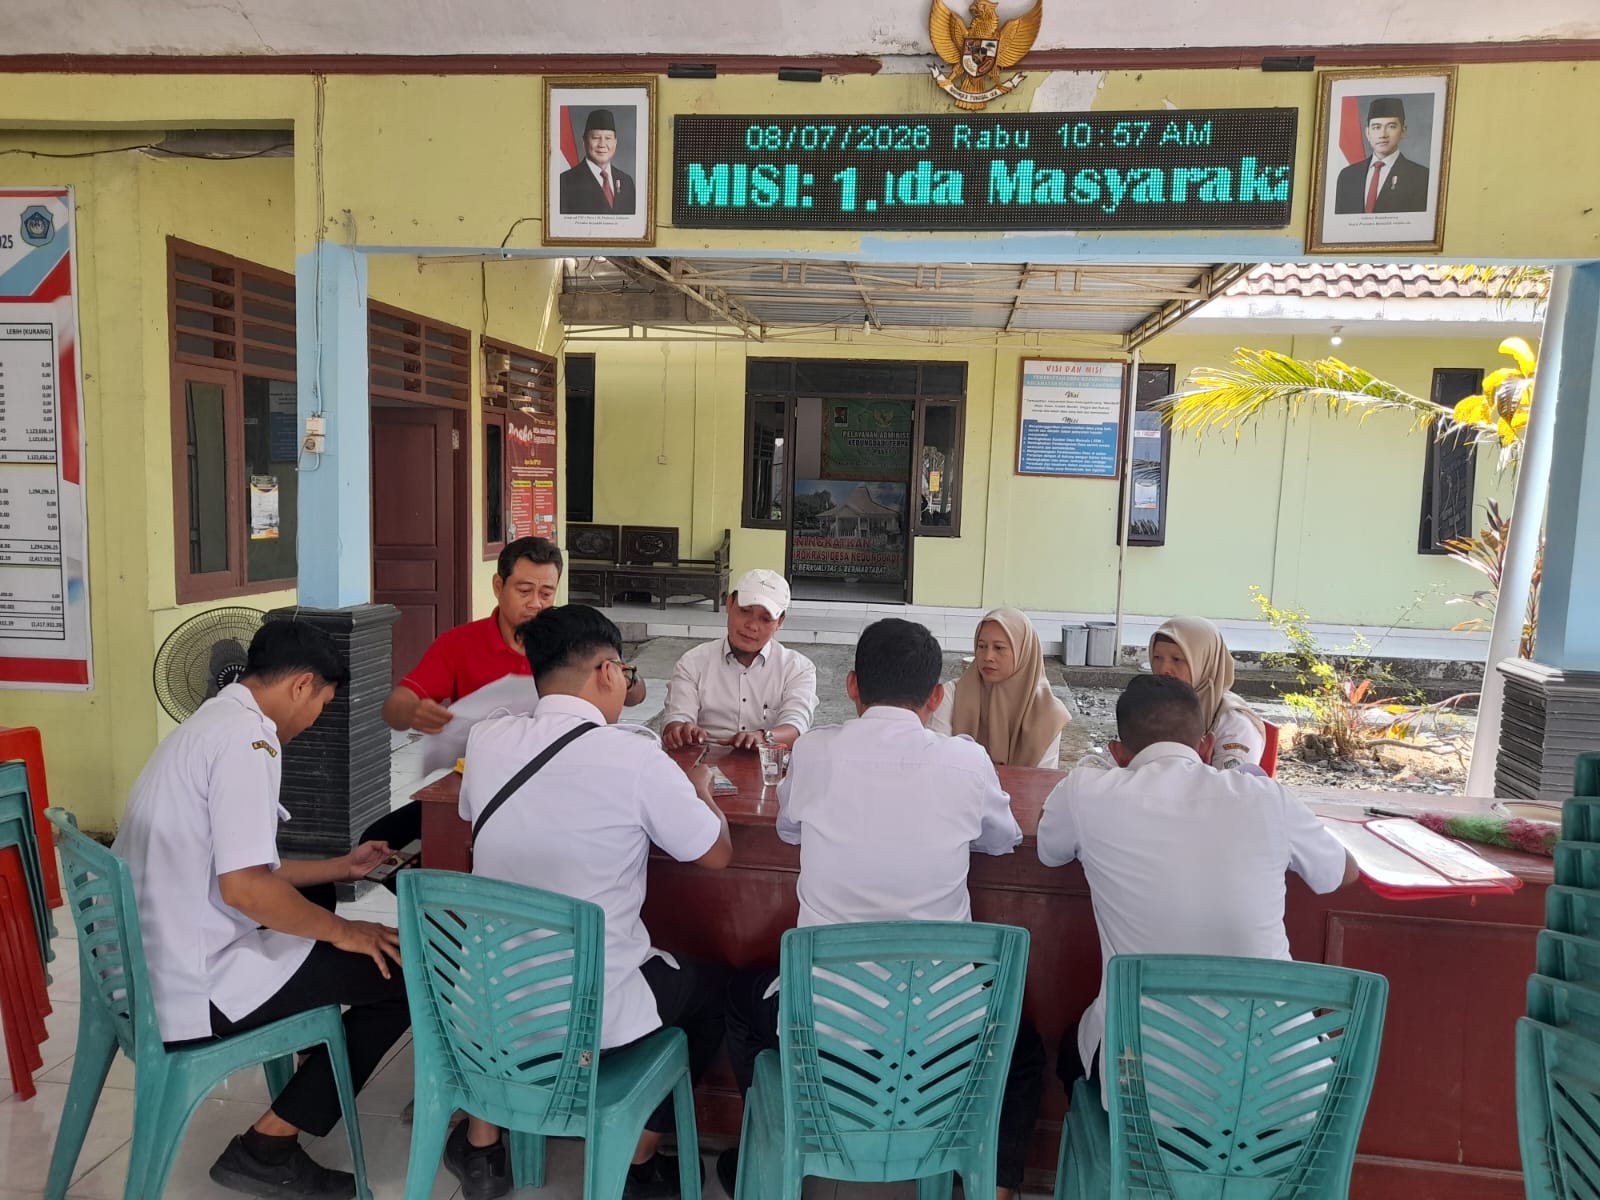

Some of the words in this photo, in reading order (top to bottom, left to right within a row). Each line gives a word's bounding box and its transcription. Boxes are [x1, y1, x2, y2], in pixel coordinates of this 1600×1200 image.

[746, 126, 931, 149] 08/07/2026
[954, 124, 1029, 149] Rabu
[1057, 122, 1151, 148] 10:57
[1159, 120, 1213, 146] AM
[688, 163, 814, 207] MISI:
[1046, 364, 1062, 372] VISI
[1065, 365, 1082, 373] DAN
[1085, 366, 1102, 374] MISI
